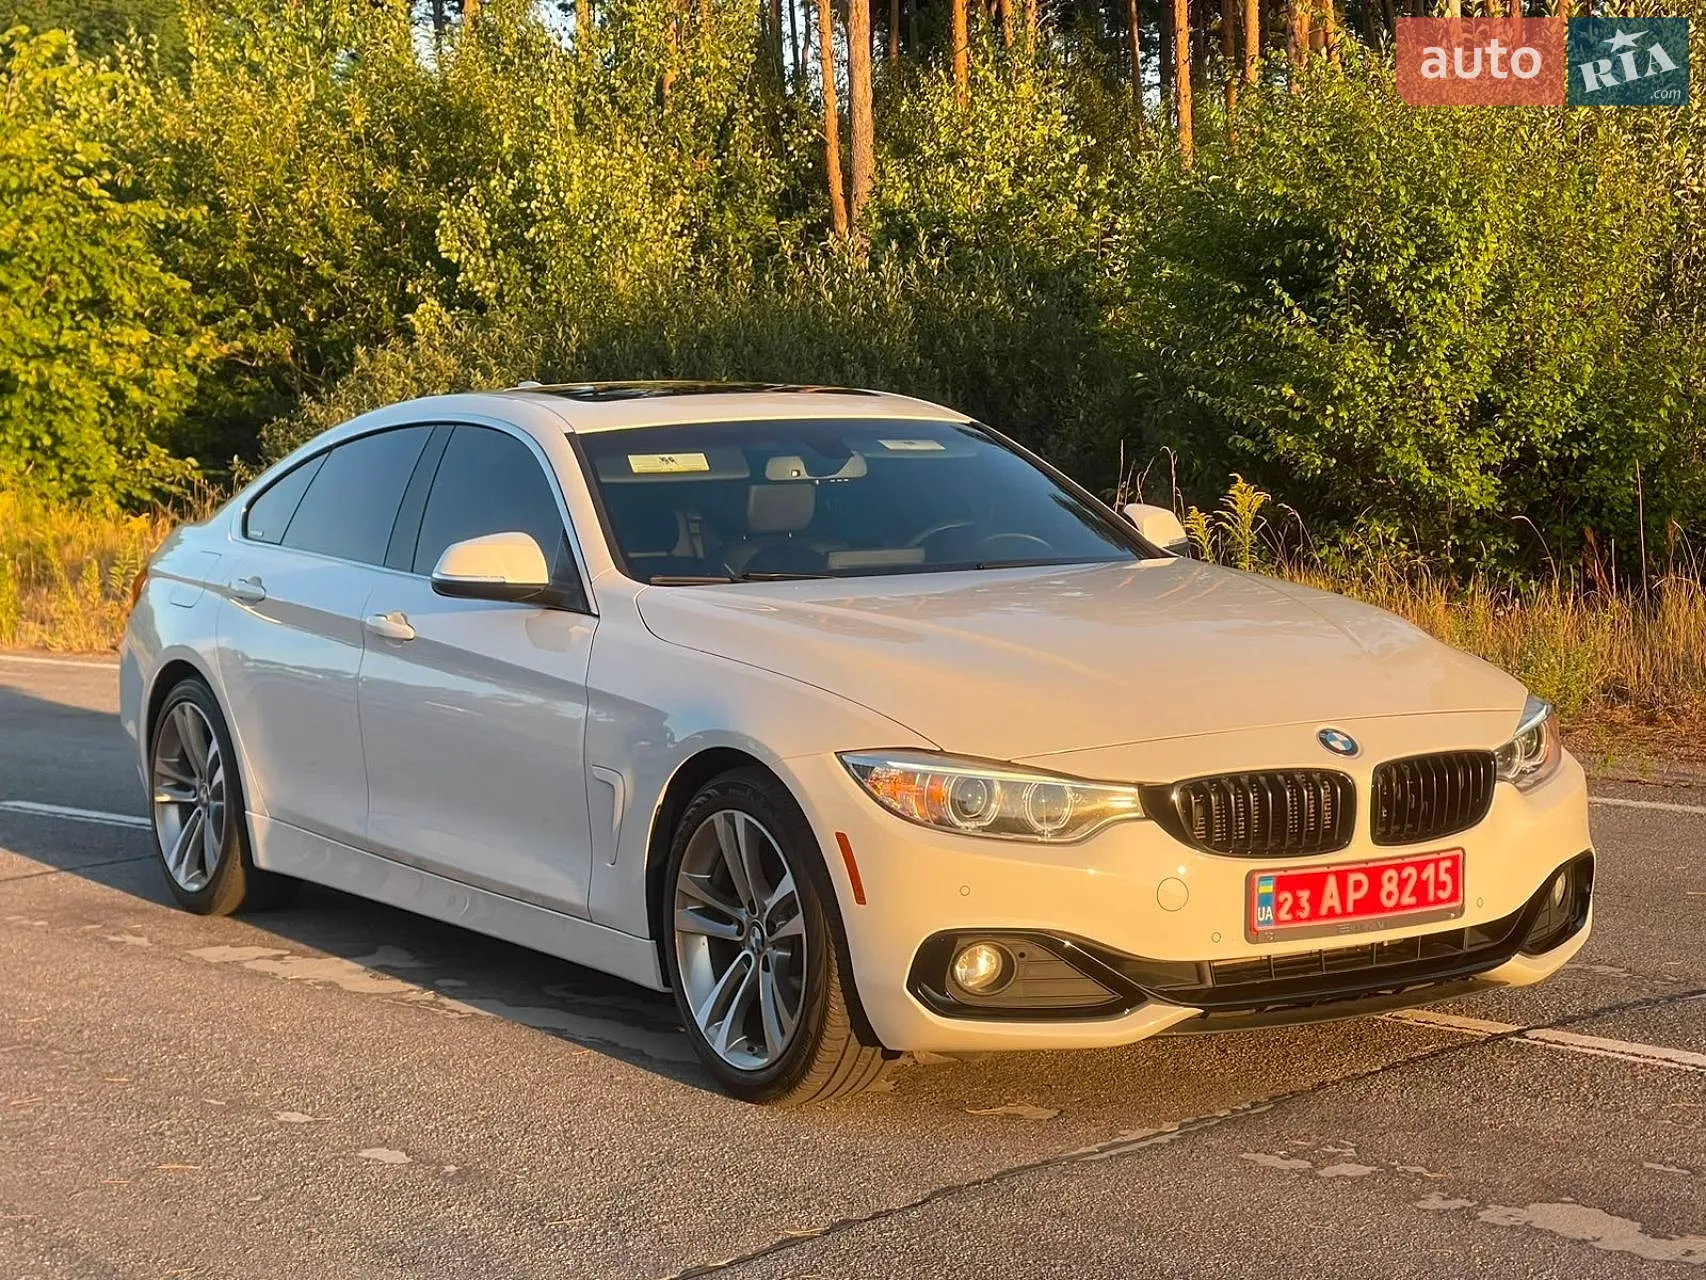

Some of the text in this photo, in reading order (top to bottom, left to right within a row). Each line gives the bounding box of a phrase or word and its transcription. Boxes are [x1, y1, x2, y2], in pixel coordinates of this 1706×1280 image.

[1278, 859, 1453, 921] 23 AP 8215
[1257, 907, 1273, 921] UA
